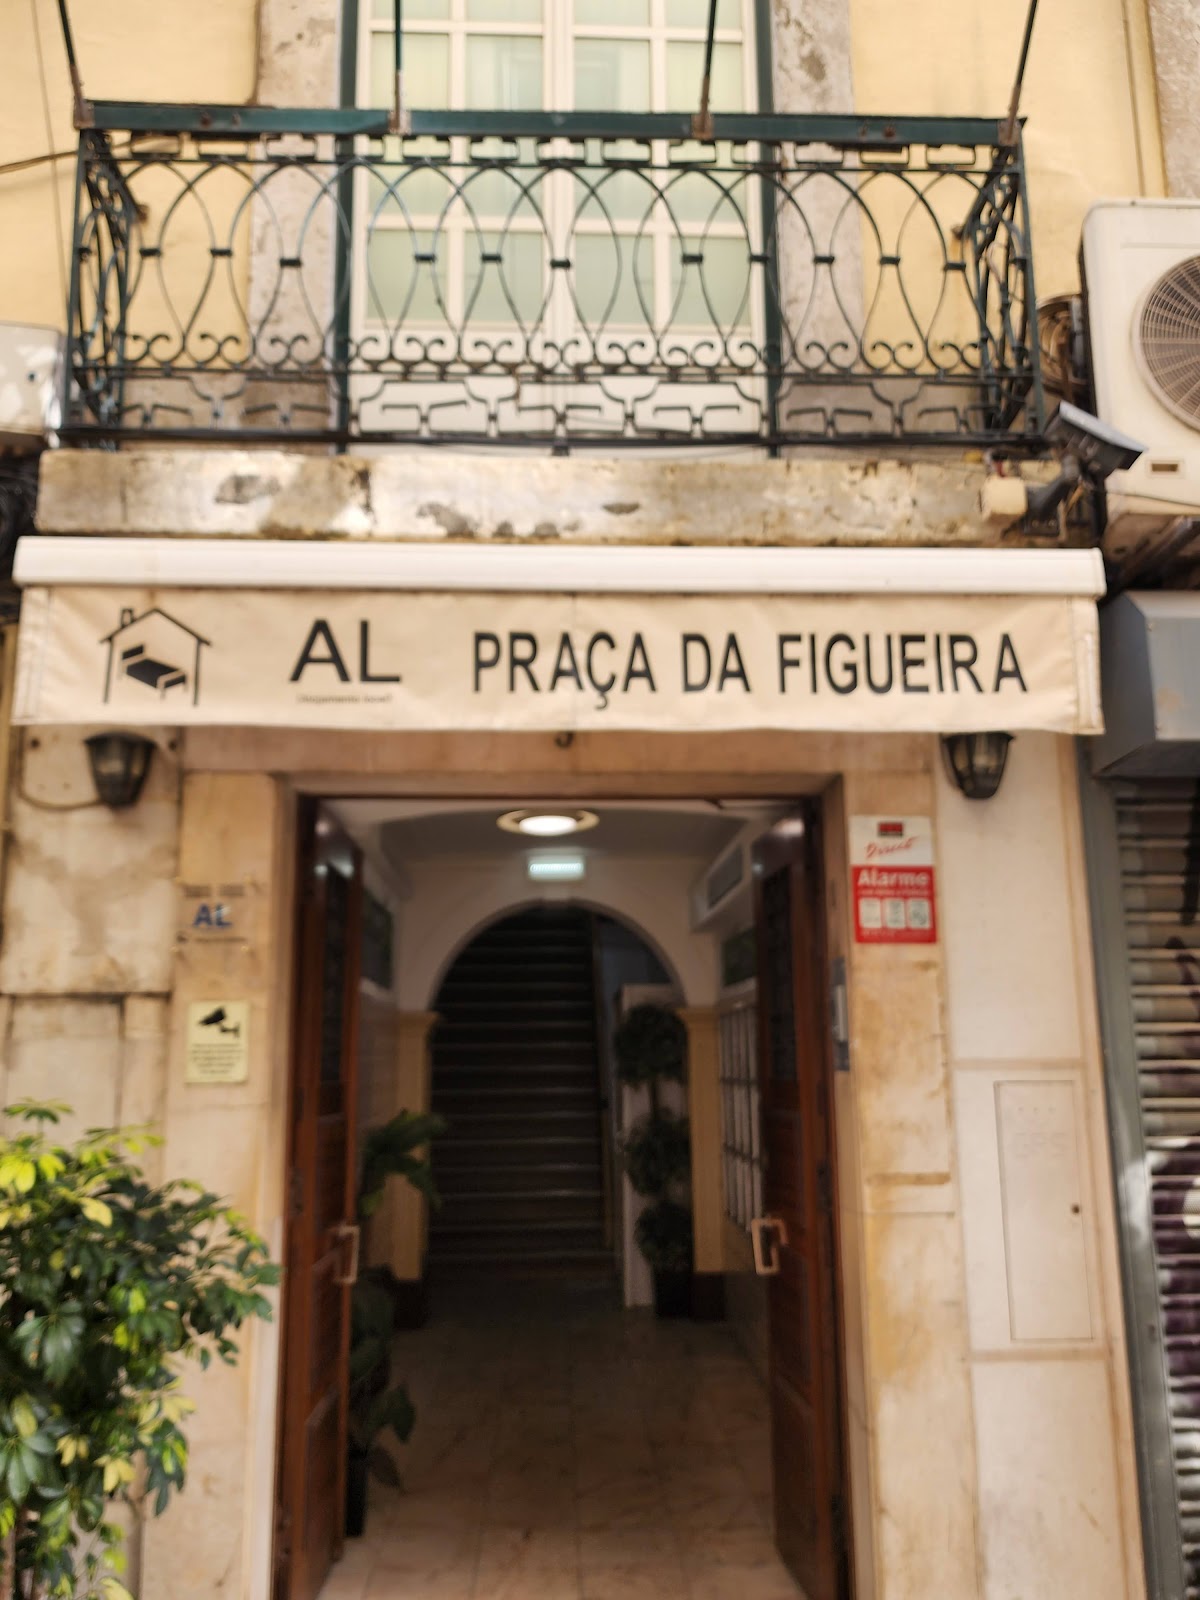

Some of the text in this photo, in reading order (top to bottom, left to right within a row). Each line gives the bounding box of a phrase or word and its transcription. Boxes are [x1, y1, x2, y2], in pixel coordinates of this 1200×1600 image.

[290, 617, 401, 683] AL
[473, 631, 1028, 709] PRAÇA DA FIGUEIRA
[858, 867, 929, 887] Alarme
[194, 904, 232, 928] AL
